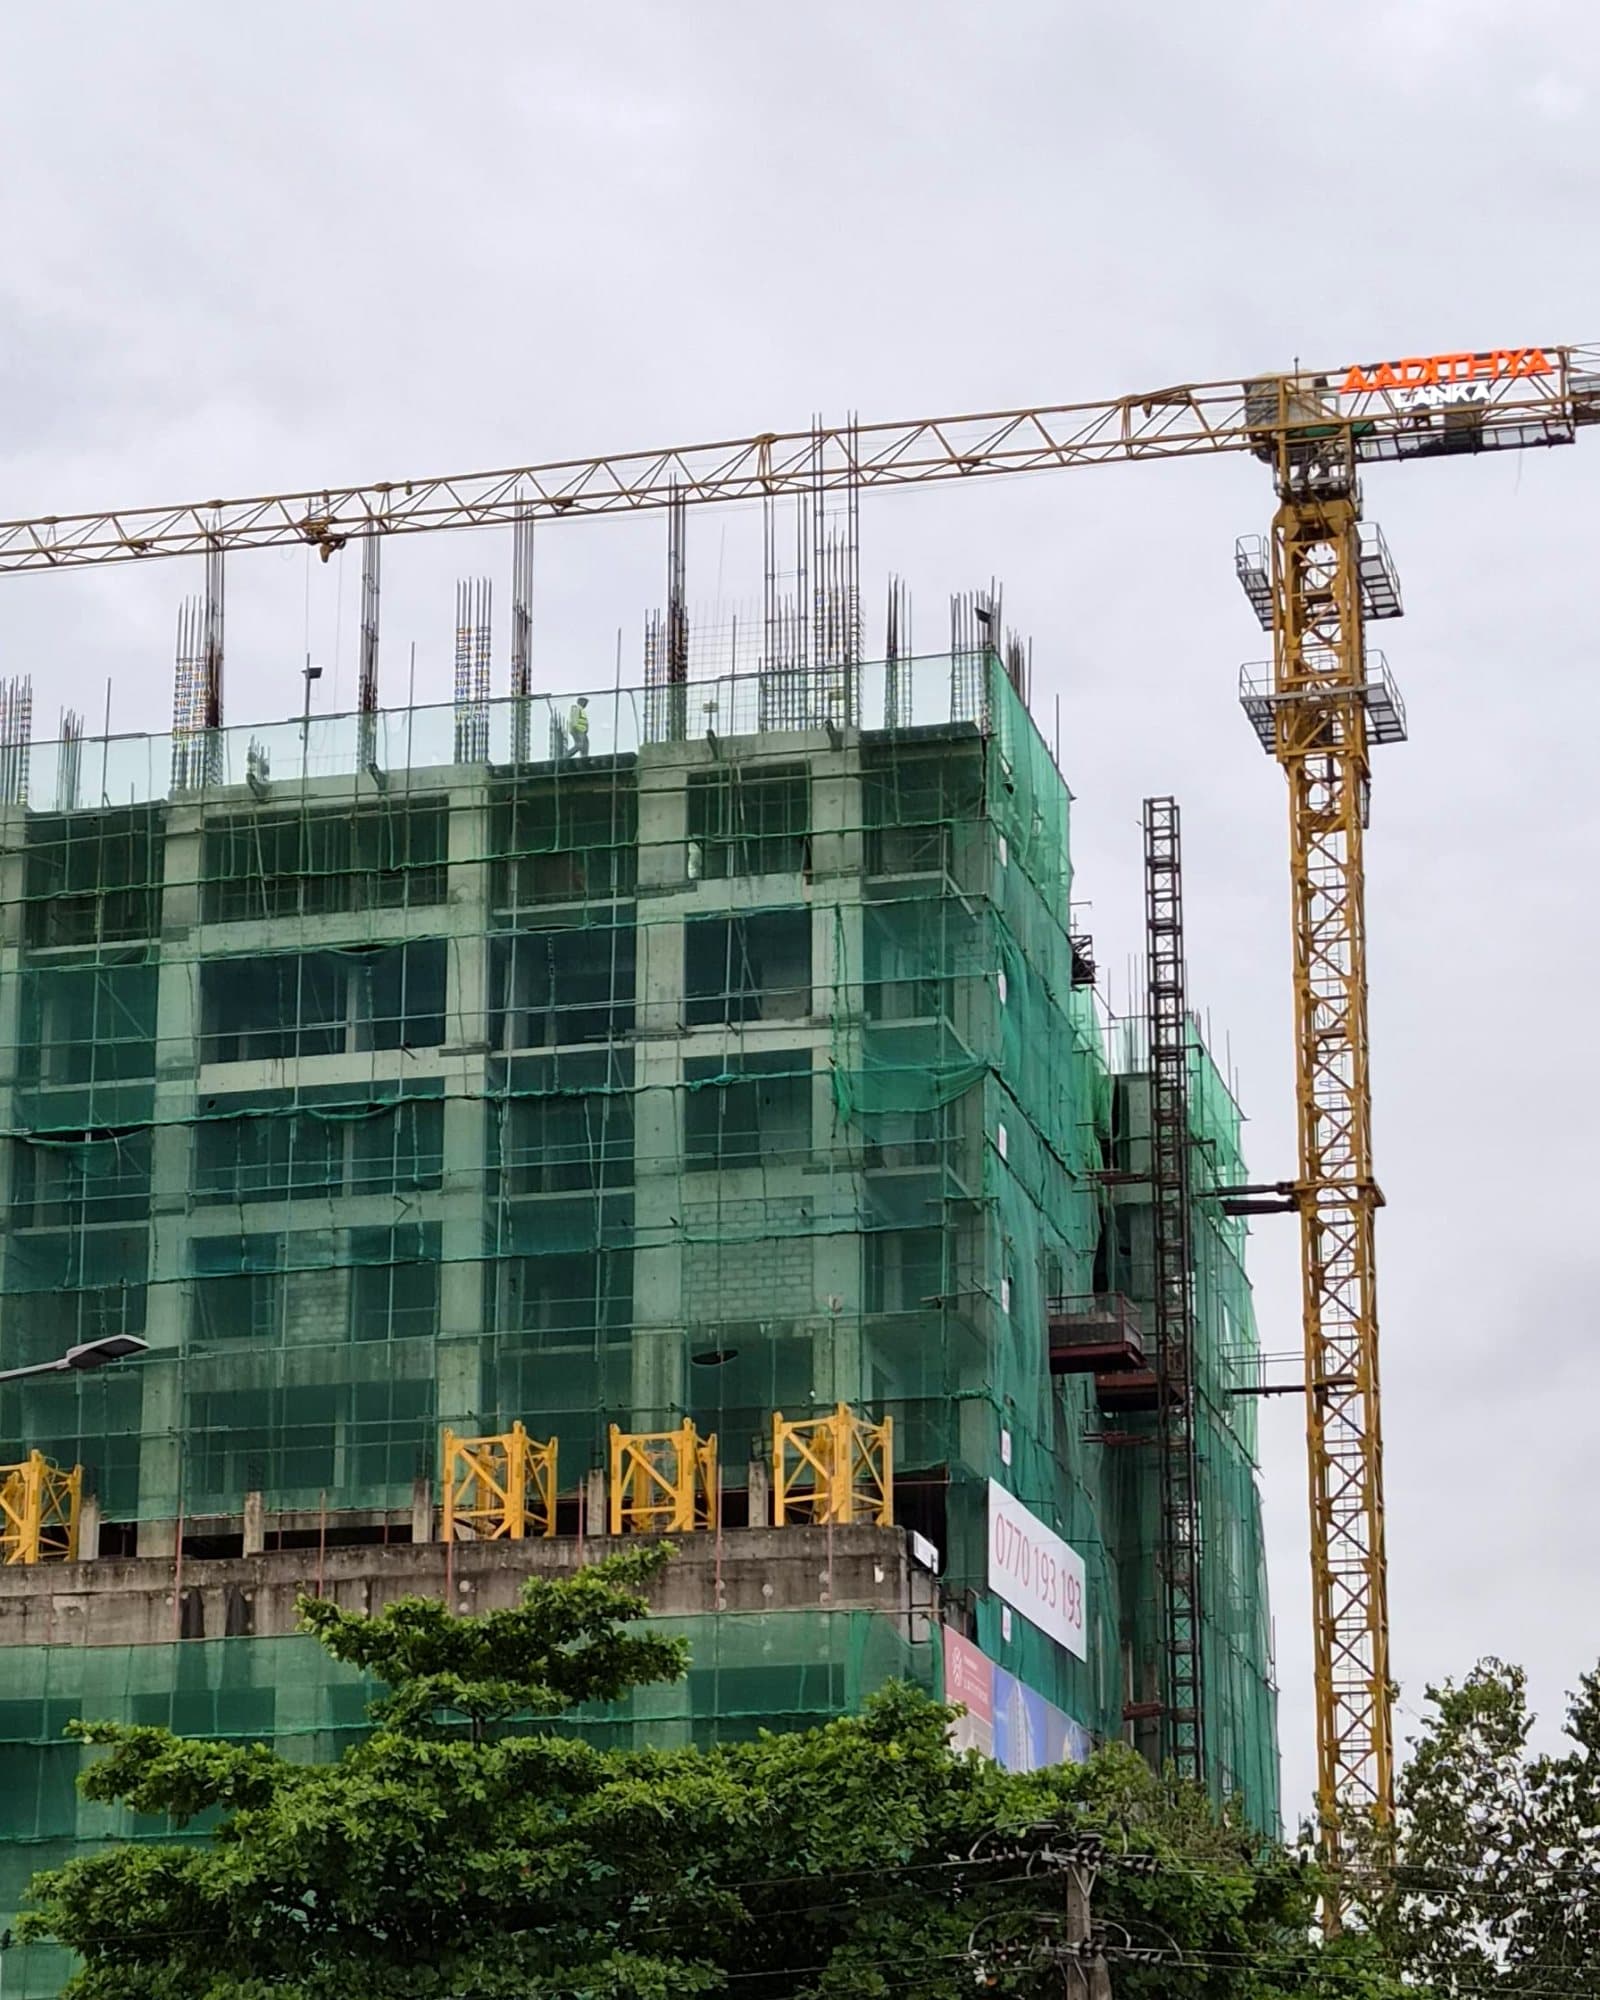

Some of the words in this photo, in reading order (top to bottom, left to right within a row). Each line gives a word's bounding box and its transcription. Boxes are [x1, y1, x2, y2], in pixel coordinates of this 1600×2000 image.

[1340, 348, 1552, 393] AADITHYA
[996, 1513, 1030, 1587] 0770
[1034, 1547, 1056, 1609] 193
[1061, 1569, 1082, 1630] 193
